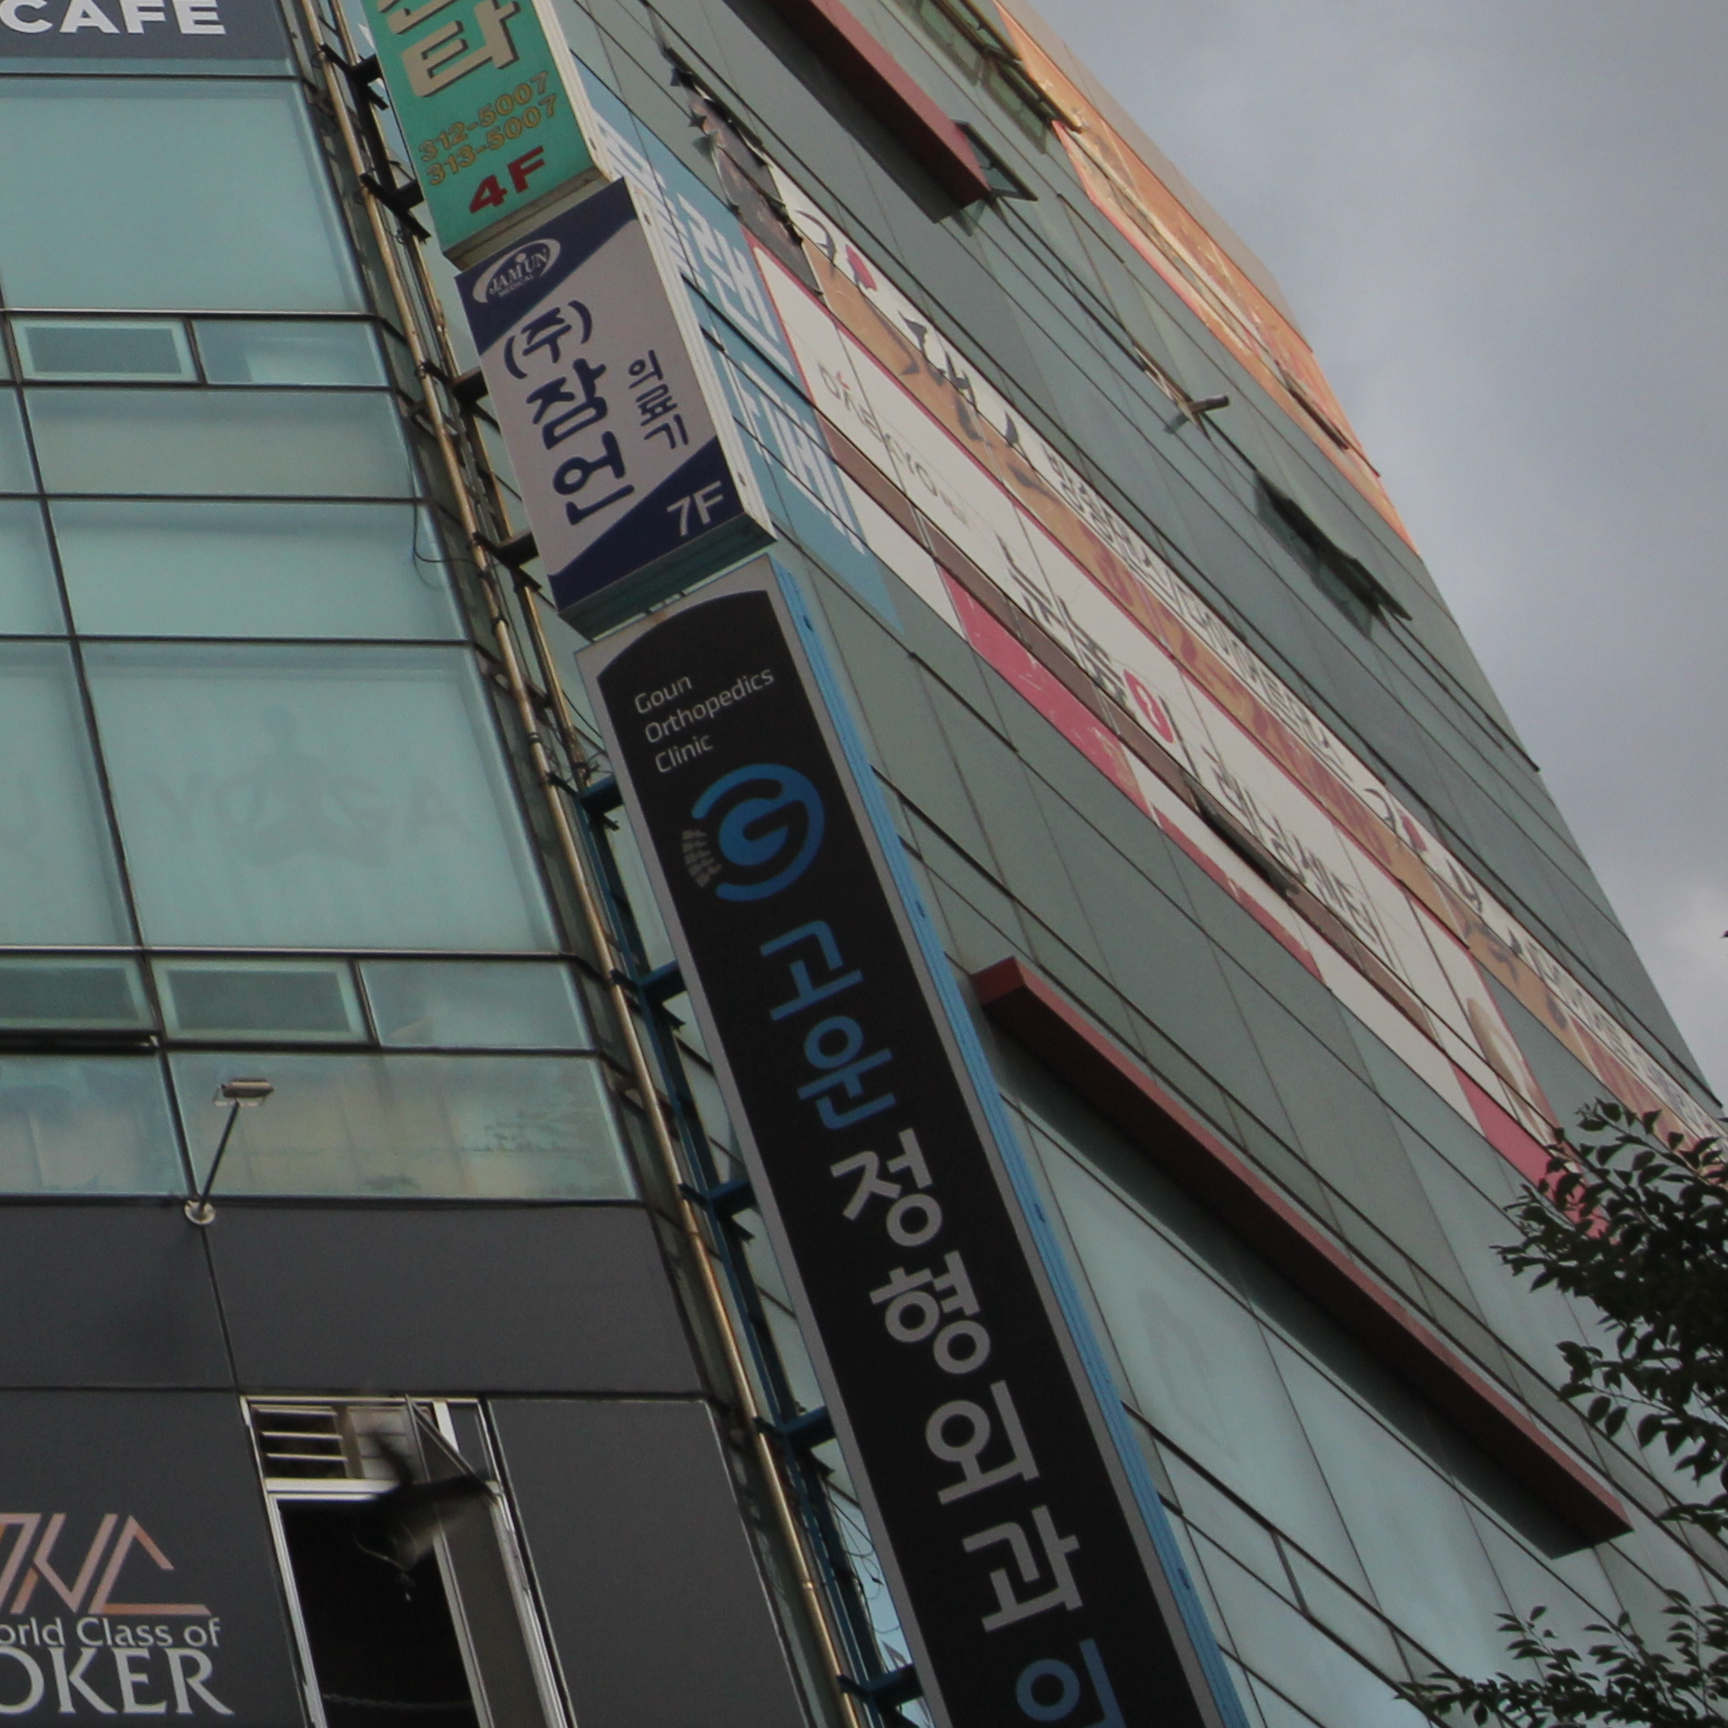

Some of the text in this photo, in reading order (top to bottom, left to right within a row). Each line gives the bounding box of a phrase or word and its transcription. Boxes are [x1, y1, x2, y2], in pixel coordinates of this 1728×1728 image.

[419, 70, 549, 162] 312-5007
[426, 93, 558, 186] 313-5007
[469, 145, 546, 214] 4F
[628, 348, 689, 450] 의료기
[667, 479, 724, 541] 7F
[635, 676, 693, 714] Goun
[645, 669, 775, 743] Orthopedics
[655, 735, 714, 773] Clinic
[76, 1617, 174, 1647] Class
[184, 1617, 222, 1647] of
